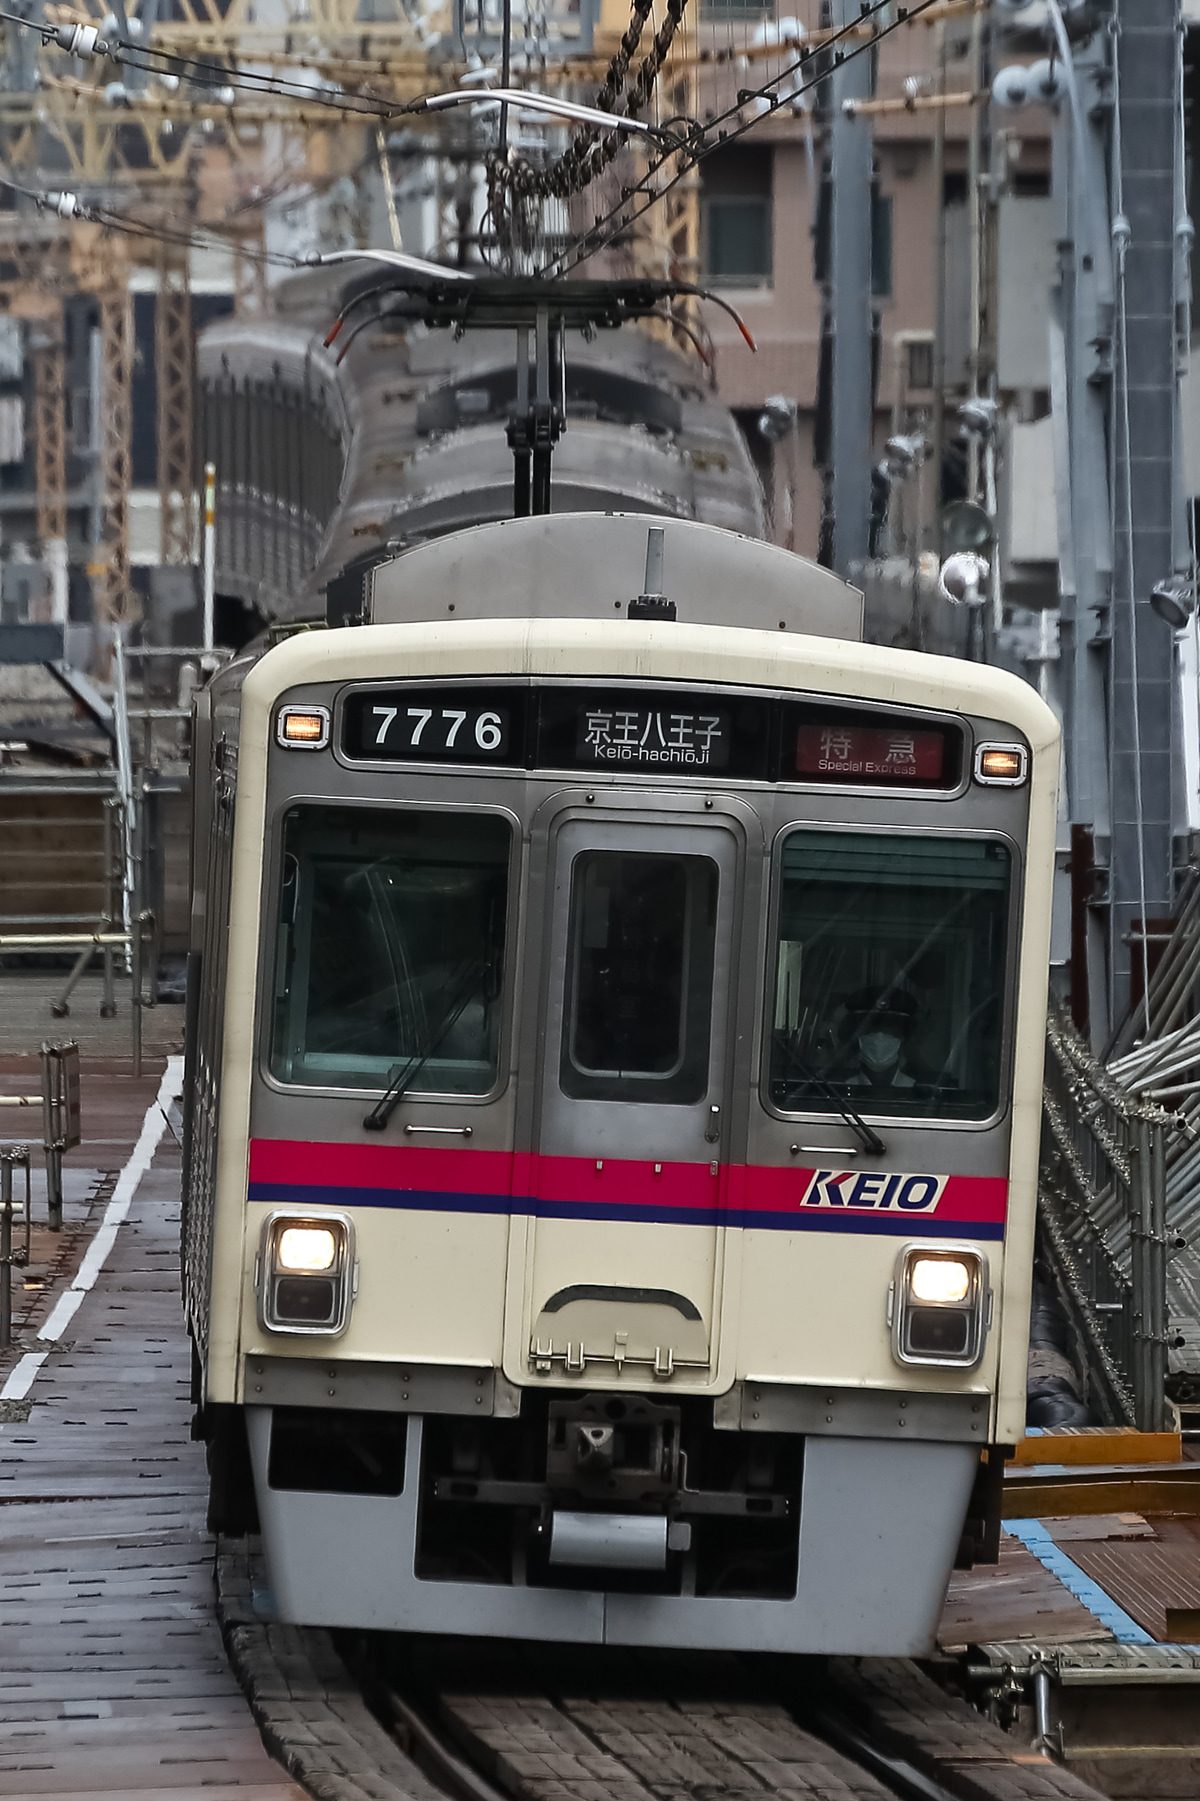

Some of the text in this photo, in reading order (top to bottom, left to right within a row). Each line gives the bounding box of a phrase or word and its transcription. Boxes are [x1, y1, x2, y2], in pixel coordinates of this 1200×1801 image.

[371, 706, 502, 751] 7776
[584, 708, 722, 750] 京王八王子
[818, 758, 917, 776] Special Express
[806, 1171, 939, 1210] KEIO
